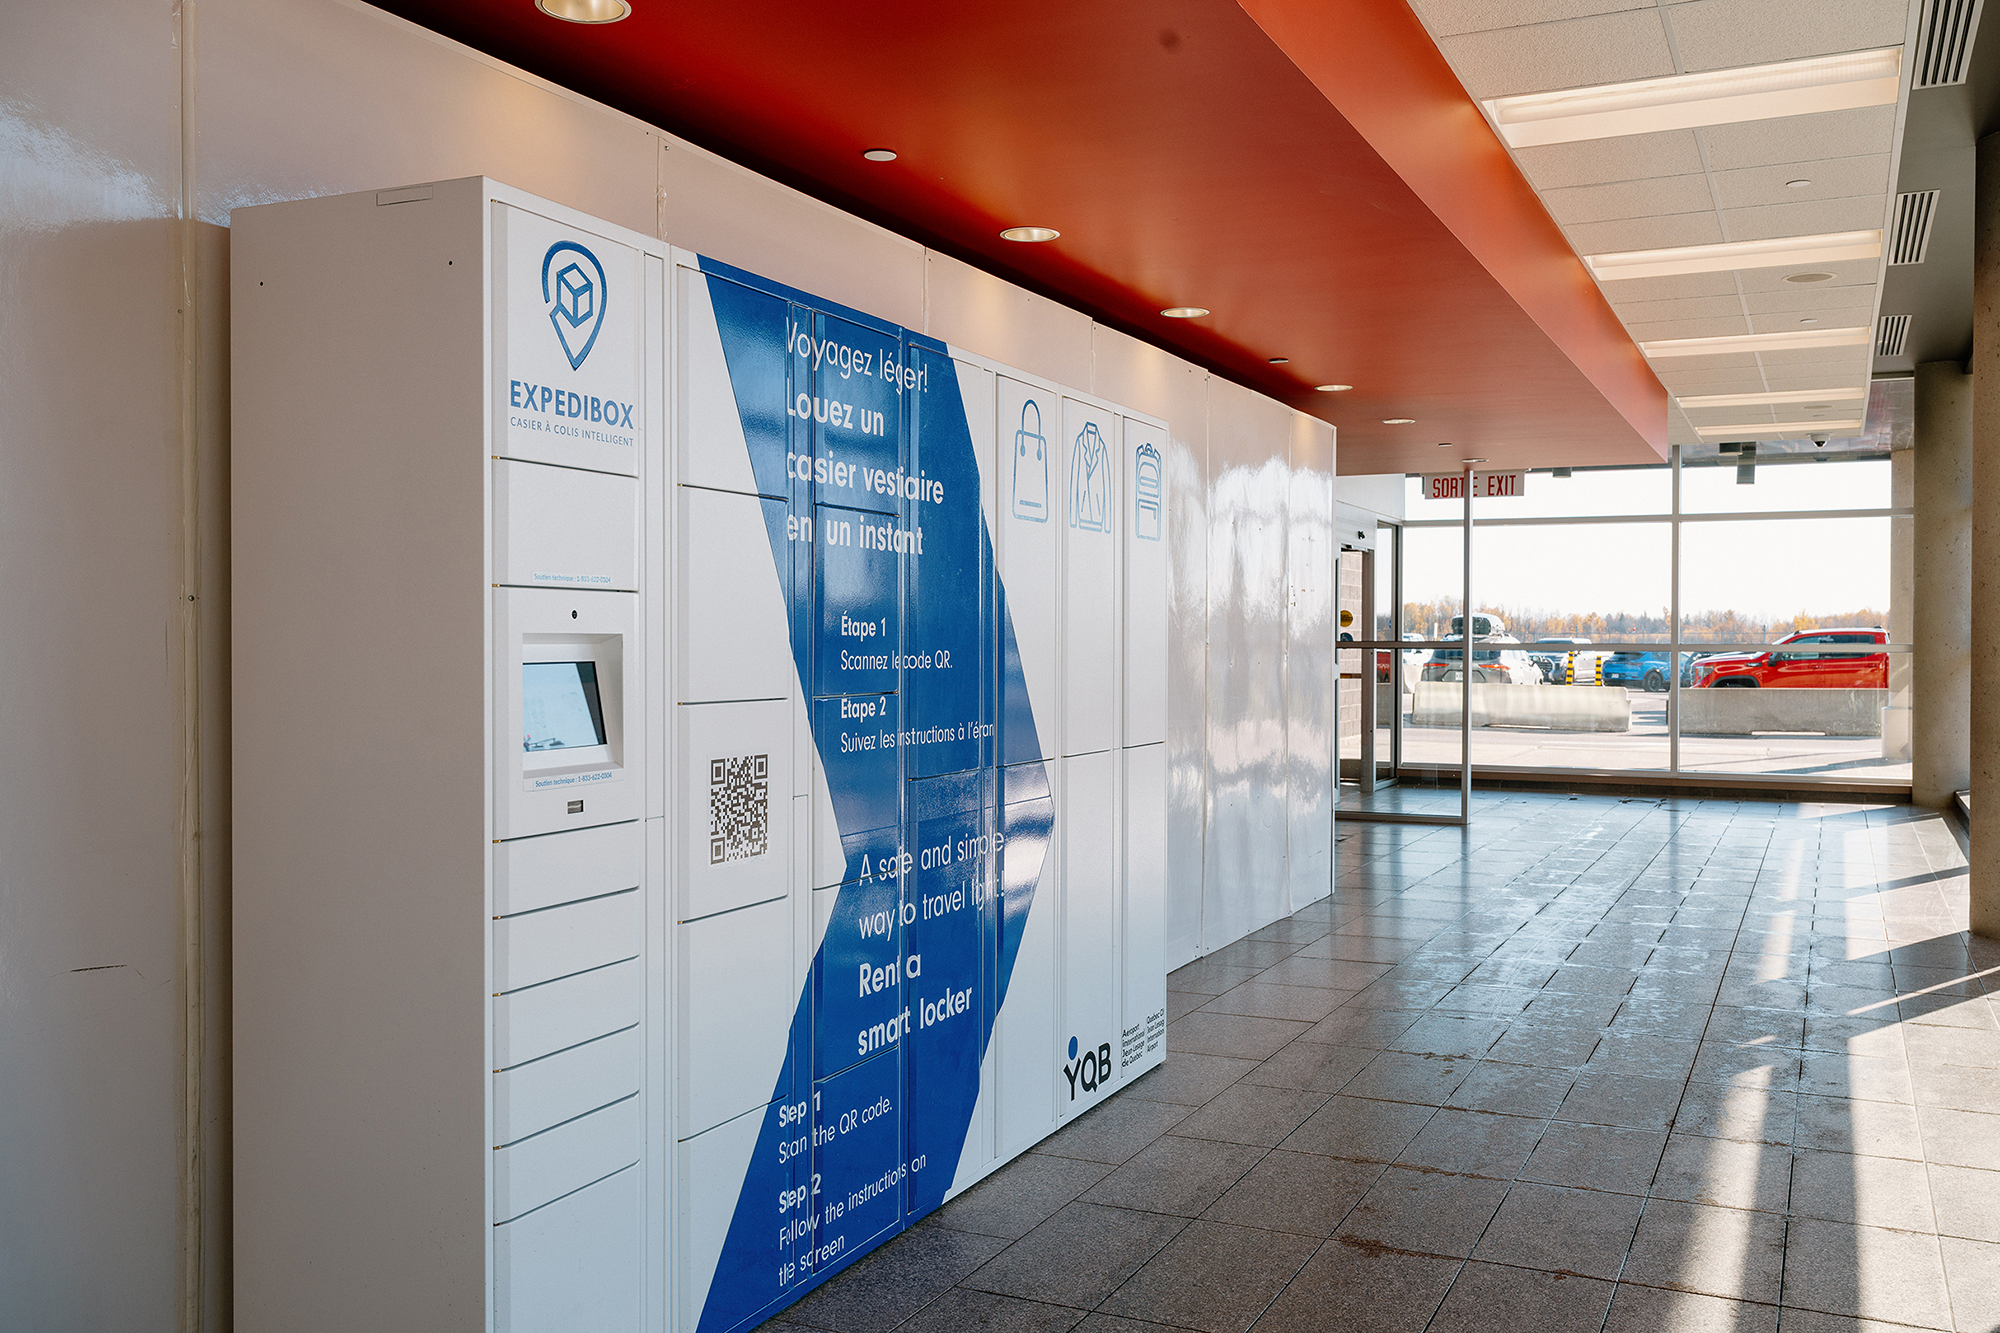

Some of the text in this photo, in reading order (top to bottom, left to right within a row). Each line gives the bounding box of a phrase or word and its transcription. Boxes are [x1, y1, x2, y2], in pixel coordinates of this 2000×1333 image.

[786, 317, 928, 395] Voyagez léger!
[510, 379, 634, 430] EXPEDIBOX
[786, 378, 884, 436] Louez un
[510, 416, 634, 447] CASIER À COLIS INTELLIGENT
[787, 450, 944, 504] casier vestiaire
[1432, 475, 1516, 498] SORTE EXIT
[787, 514, 923, 555] en un instant
[552, 574, 574, 583] technique
[841, 610, 886, 642] Étape 1
[840, 650, 953, 670] Scannez le code QR.
[879, 696, 886, 716] 2
[840, 732, 876, 753] Suivez
[880, 729, 895, 748] les
[958, 723, 965, 741] à
[535, 779, 552, 788] Soutien
[553, 776, 574, 785] technique
[859, 853, 873, 886] A
[921, 835, 951, 870] and
[957, 827, 1004, 864] simple
[859, 908, 895, 941] way
[899, 899, 916, 926] to
[922, 881, 966, 920] travel
[859, 954, 921, 998] Rent a
[858, 987, 972, 1056] smart locker
[1062, 1042, 1111, 1102] YQB
[813, 1090, 821, 1111] 1
[779, 1096, 893, 1164] Scan the QR code.
[780, 1154, 926, 1250] Follow the instructions on
[811, 1173, 821, 1195] 2
[800, 1235, 845, 1271] screen
